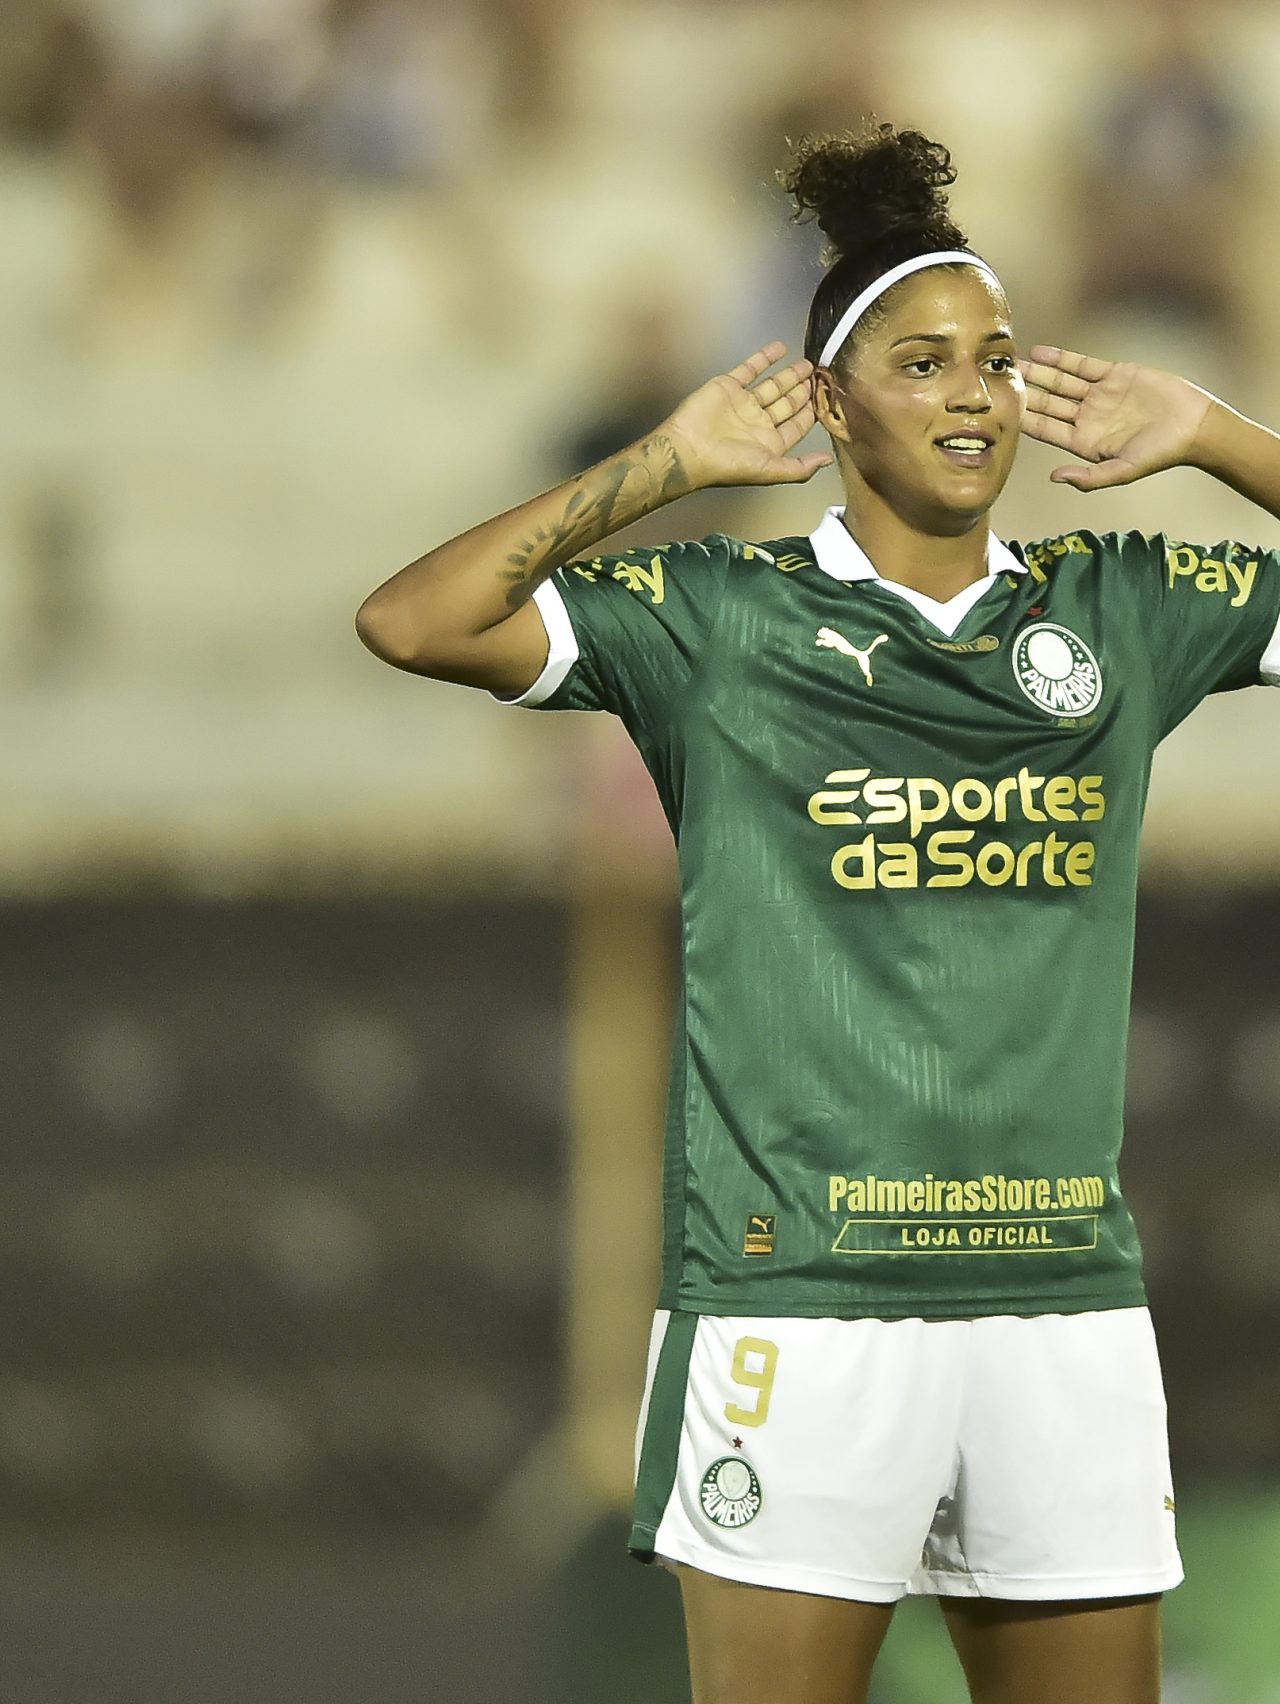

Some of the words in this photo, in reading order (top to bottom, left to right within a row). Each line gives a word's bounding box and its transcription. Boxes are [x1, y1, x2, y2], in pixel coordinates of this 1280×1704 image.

[1020, 662, 1096, 711] PALMEIRAS
[807, 766, 1105, 839] Esportes
[828, 1173, 1104, 1212] PalmeirasStore.com
[901, 1227, 961, 1246] LOJA
[968, 1226, 1053, 1246] OFICIAL
[723, 1335, 780, 1428] 9
[701, 1482, 760, 1527] PALMEIRAS
